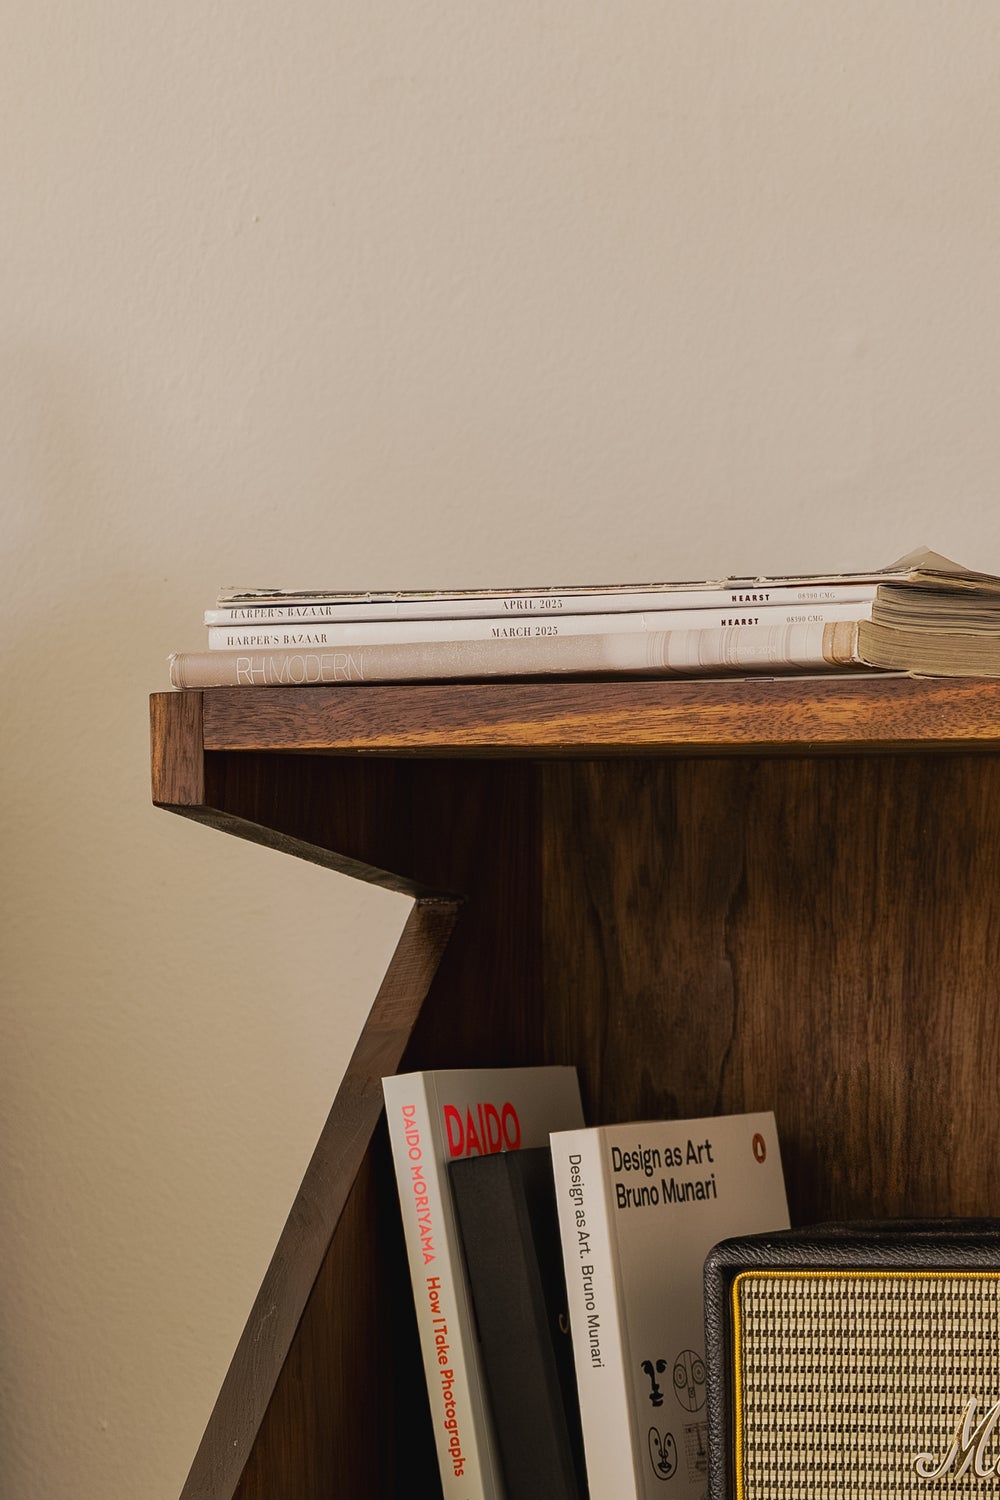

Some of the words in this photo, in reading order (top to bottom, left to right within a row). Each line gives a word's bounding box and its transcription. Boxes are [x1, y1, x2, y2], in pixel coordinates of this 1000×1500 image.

[230, 607, 284, 619] HARPER'S
[287, 606, 332, 617] BAZAAR
[502, 600, 536, 610] APRIL
[539, 599, 563, 609] 2025
[731, 594, 770, 602] HEARST
[819, 591, 836, 599] CMG
[491, 626, 531, 638] MARCH
[535, 626, 558, 636] 2025
[720, 617, 759, 627] HEARST
[807, 614, 824, 622] CMG
[226, 634, 280, 646] HARPER'S
[283, 633, 328, 645] BAZAAR
[401, 1104, 423, 1162] DAIDO
[443, 1101, 521, 1158] DAIDO
[610, 1144, 662, 1178] Design
[664, 1146, 683, 1168] as
[685, 1138, 714, 1166] Art
[568, 1153, 585, 1207] Design
[615, 1183, 660, 1209] Bruno
[660, 1173, 718, 1205] Munari
[410, 1165, 436, 1266] MORIYAMA
[575, 1209, 587, 1228] as
[577, 1230, 591, 1260] Art.
[426, 1276, 442, 1314] How
[581, 1264, 596, 1311] Bruno
[434, 1324, 450, 1366] Take
[586, 1314, 606, 1369] Munari
[439, 1368, 466, 1478] Photographs
